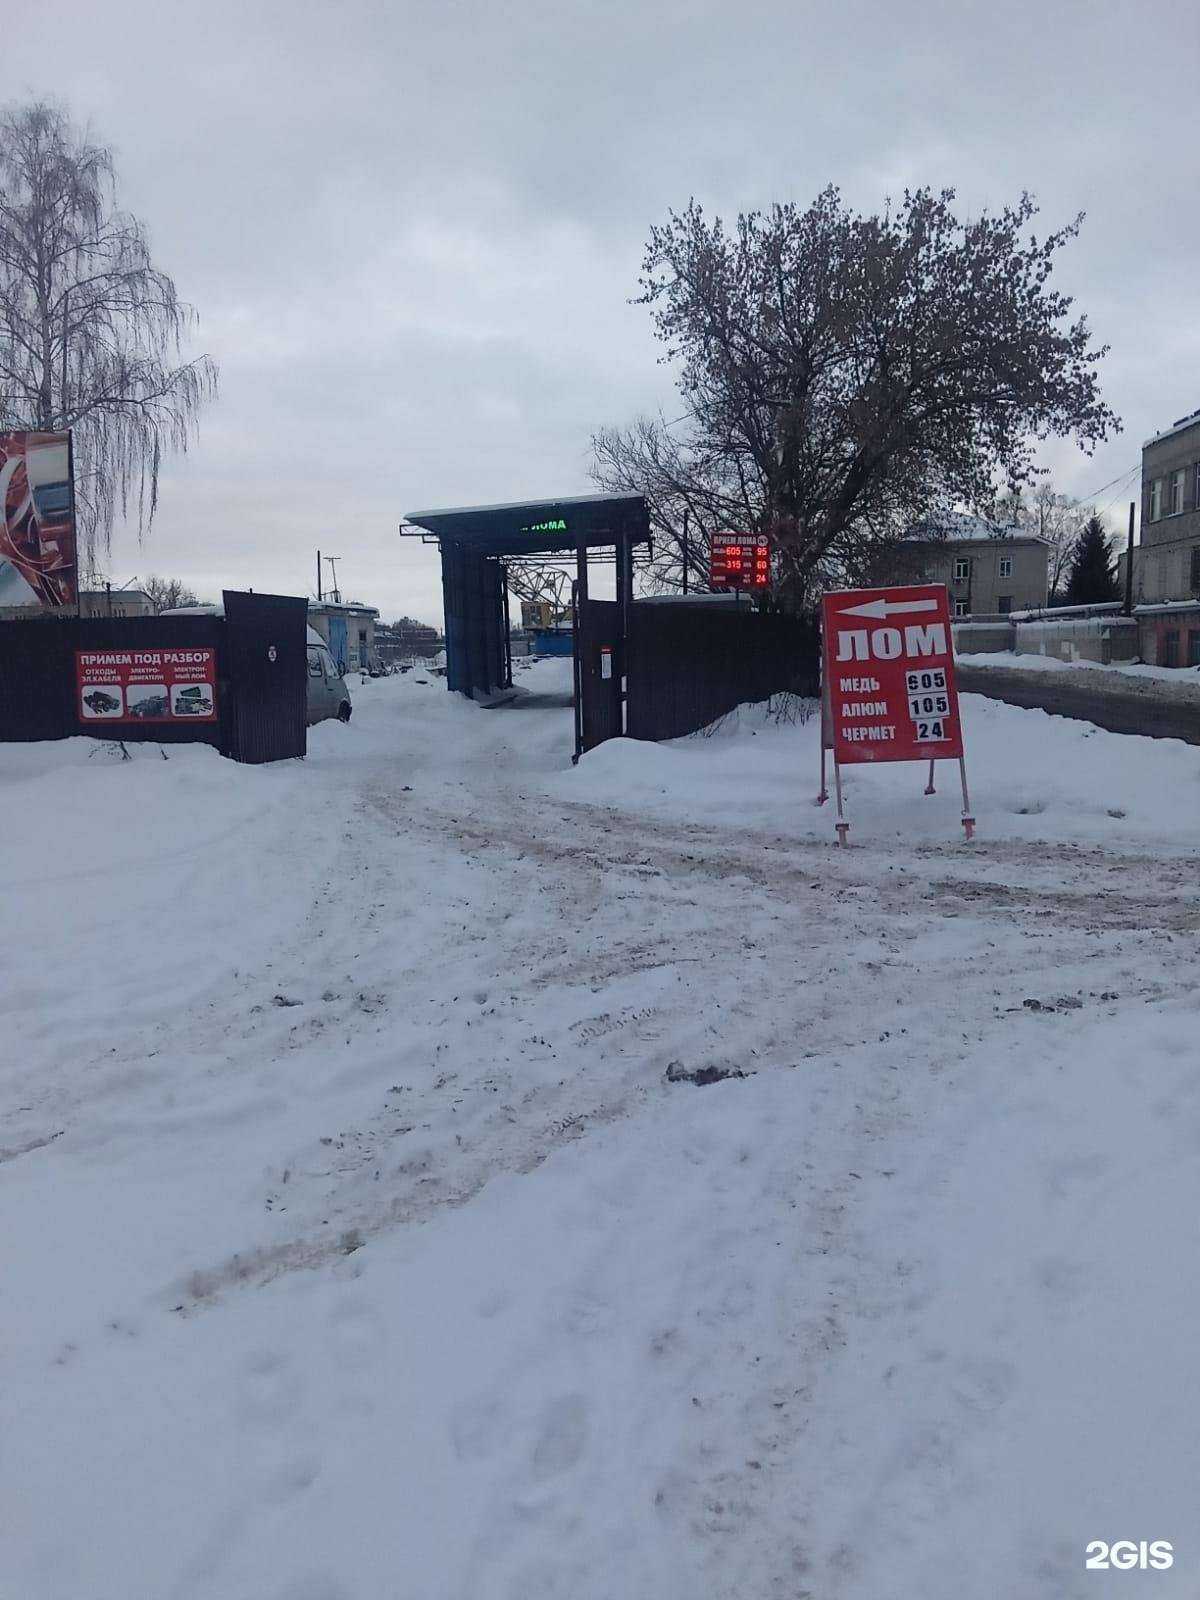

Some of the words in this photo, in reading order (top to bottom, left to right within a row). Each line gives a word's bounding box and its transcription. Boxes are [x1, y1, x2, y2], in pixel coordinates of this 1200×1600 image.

[757, 547, 768, 556] 95
[726, 560, 742, 569] 315
[835, 623, 948, 662] ЛОМ
[80, 654, 132, 665] ПРИМЕМ
[134, 653, 161, 665] ПОД
[164, 652, 210, 663] РАЗБОР
[85, 668, 117, 676] ОТХОДЫ
[840, 677, 880, 693] МЕДЬ
[908, 672, 945, 690] 605
[841, 701, 888, 717] АЛЮМ
[911, 697, 948, 715] 105
[842, 725, 896, 742] ЧЕРМЕТ
[918, 722, 943, 739] 24
